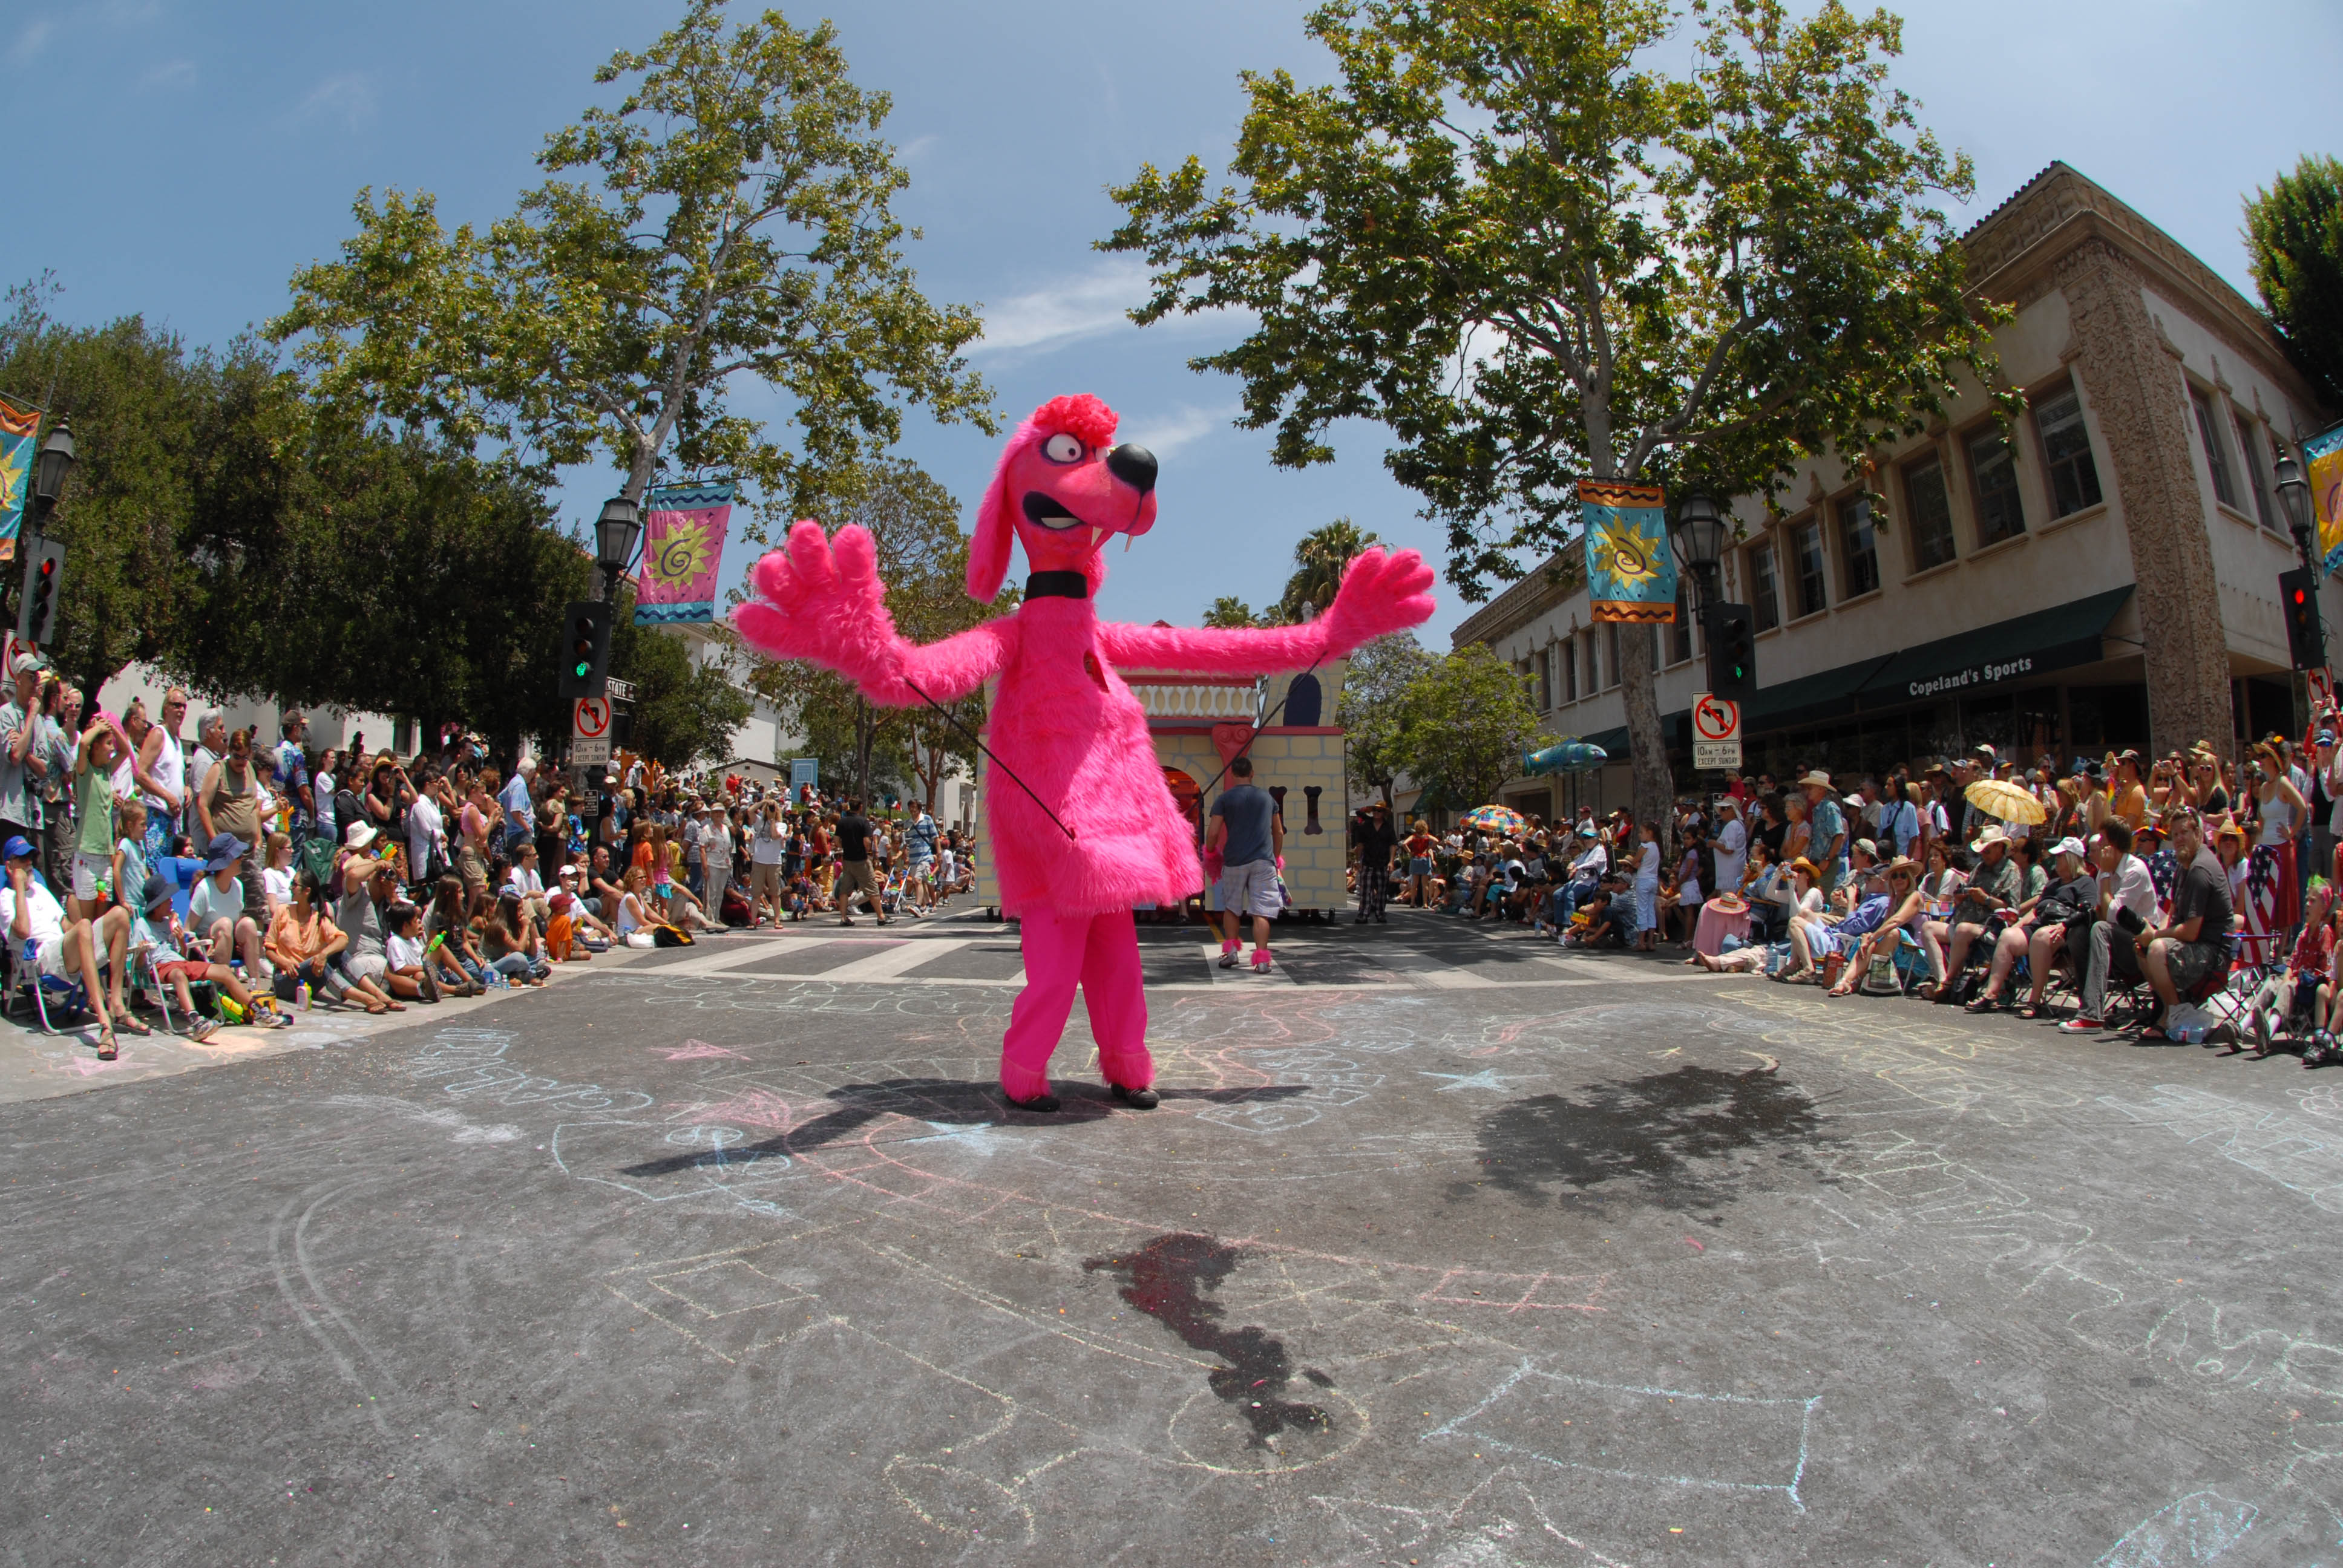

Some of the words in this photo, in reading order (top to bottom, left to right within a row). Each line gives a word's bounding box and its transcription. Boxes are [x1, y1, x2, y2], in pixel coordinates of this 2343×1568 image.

[1909, 669, 1979, 696] Copeland's
[1984, 658, 2032, 681] Sports
[607, 680, 627, 697] STATE
[1697, 746, 1712, 756] 10AM
[1722, 746, 1735, 754] 6PM
